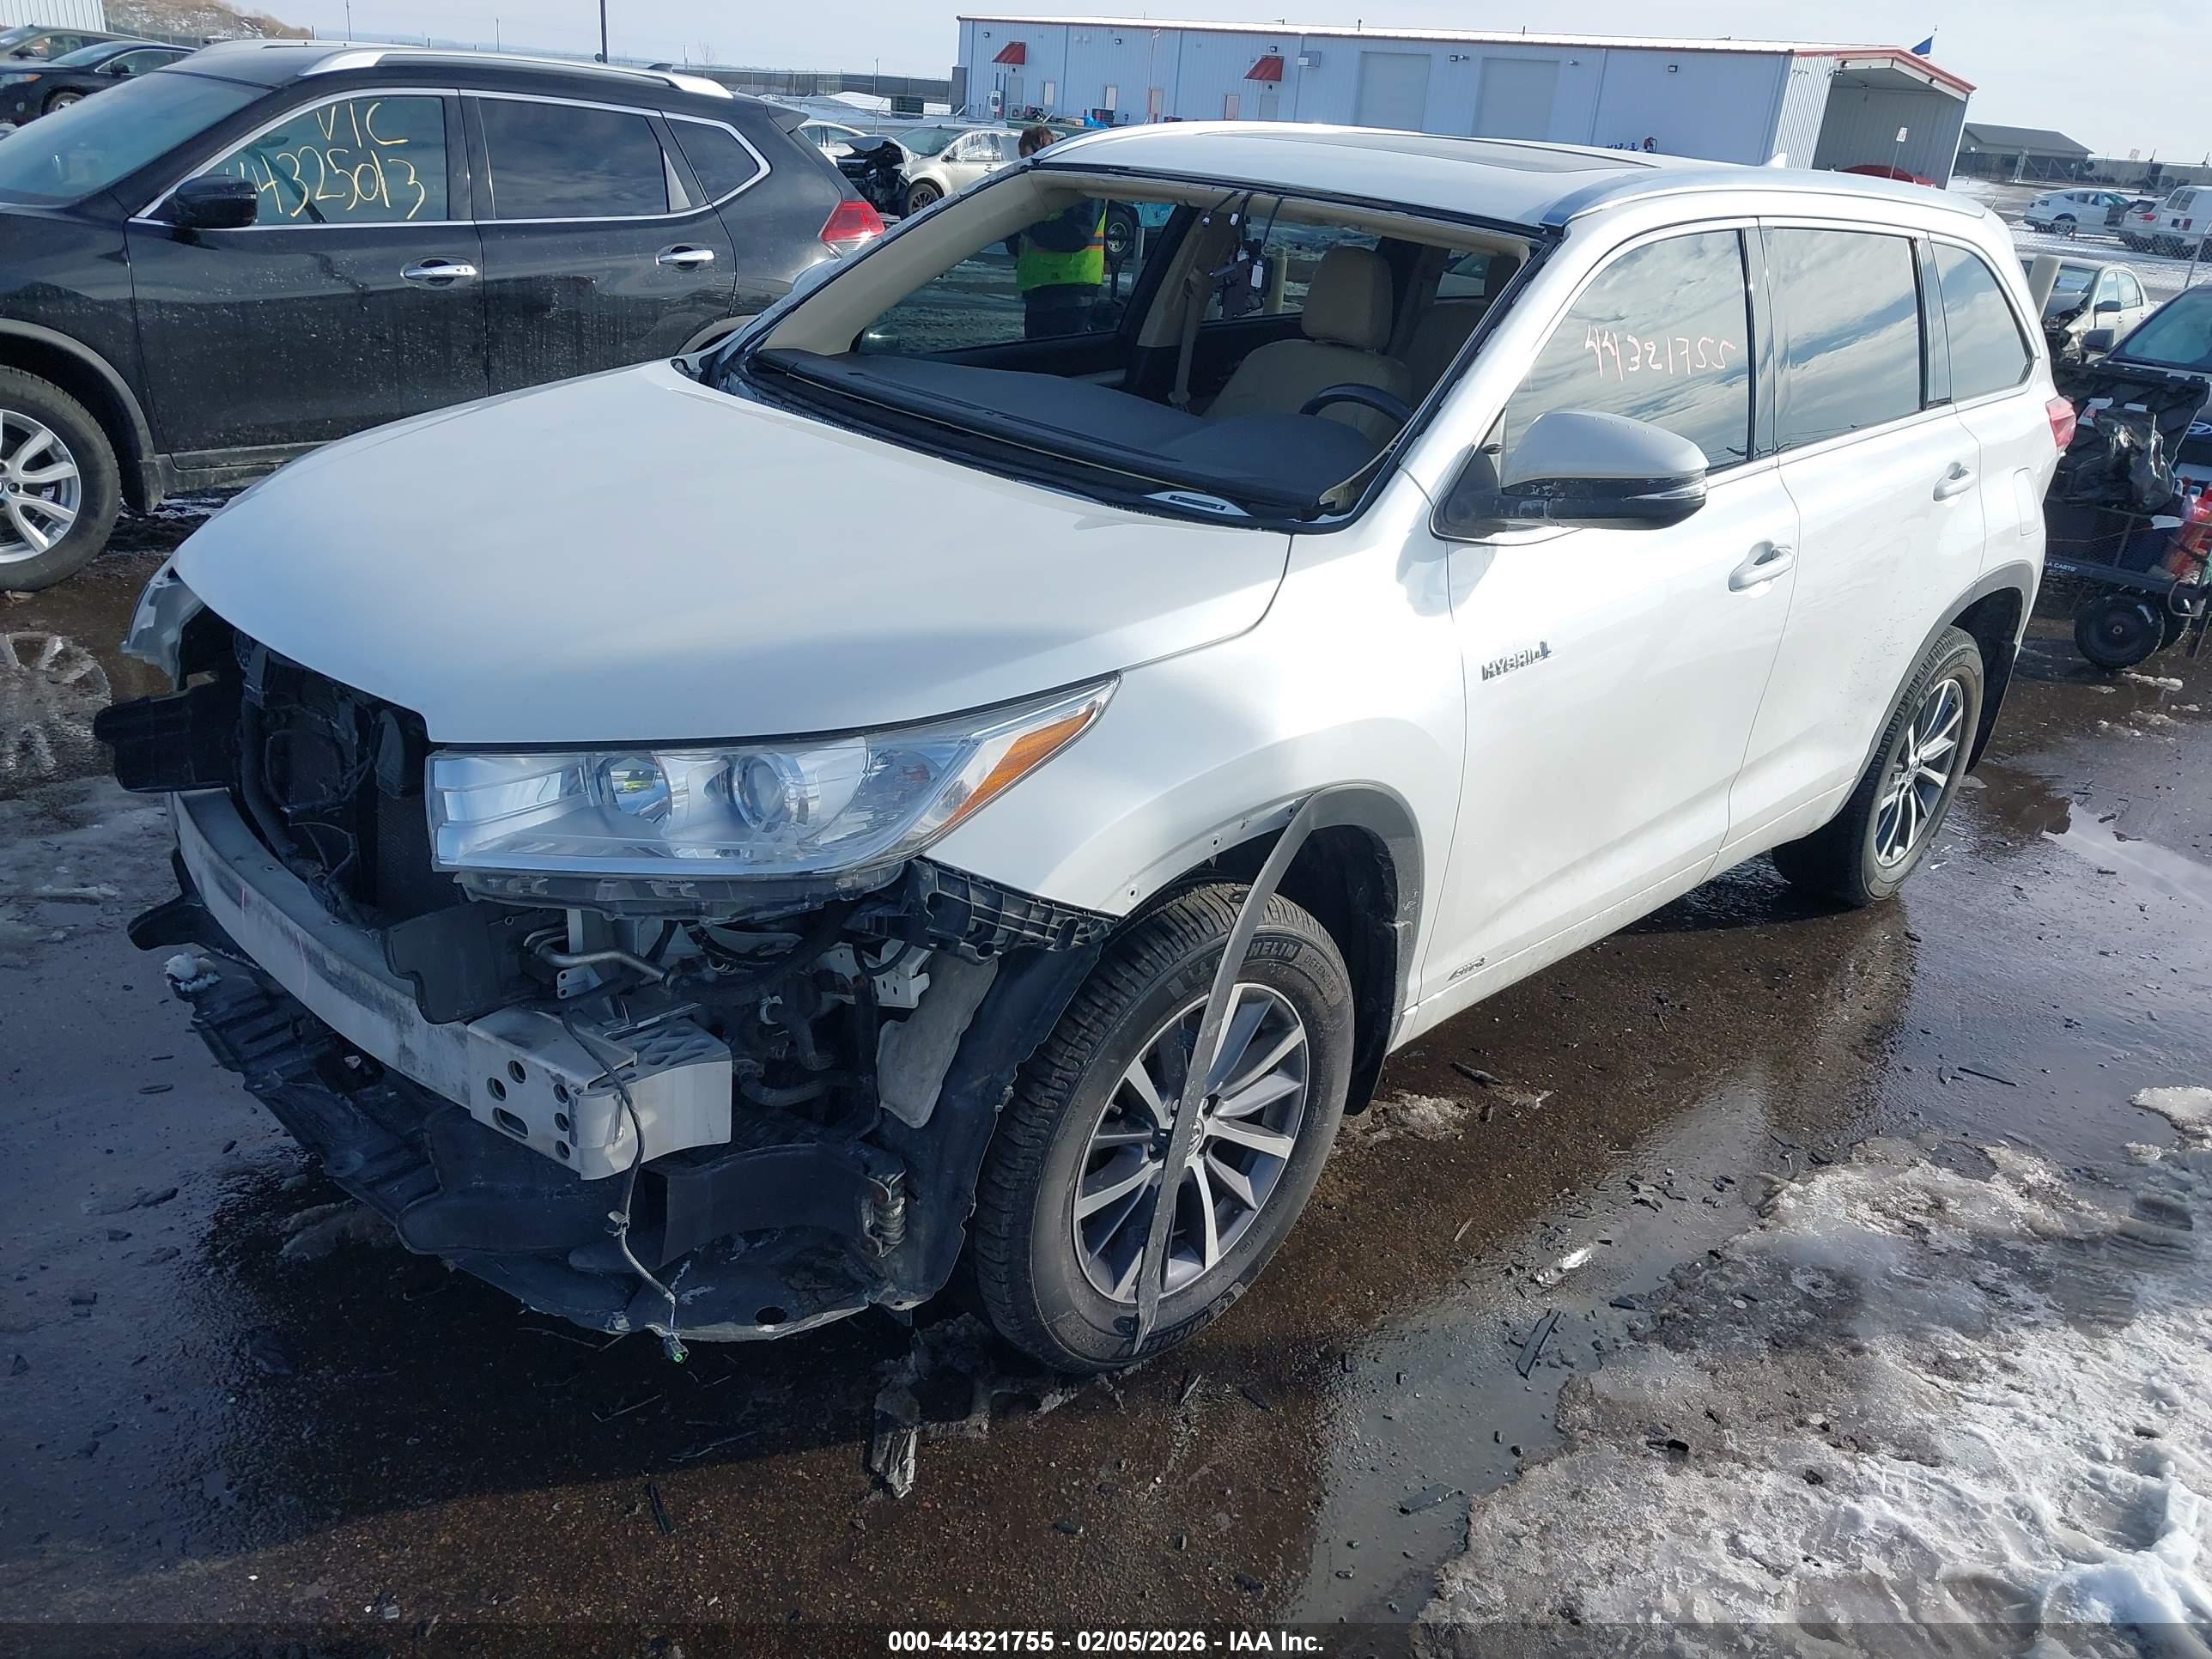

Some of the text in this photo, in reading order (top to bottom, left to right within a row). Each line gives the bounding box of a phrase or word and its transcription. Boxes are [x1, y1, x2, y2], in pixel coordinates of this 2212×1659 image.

[316, 101, 409, 149] VIC
[224, 145, 426, 220] 4325013
[1584, 324, 1736, 381] 44321755
[1481, 641, 1552, 682] HYBRID
[1304, 954, 1339, 994] DEFENDER
